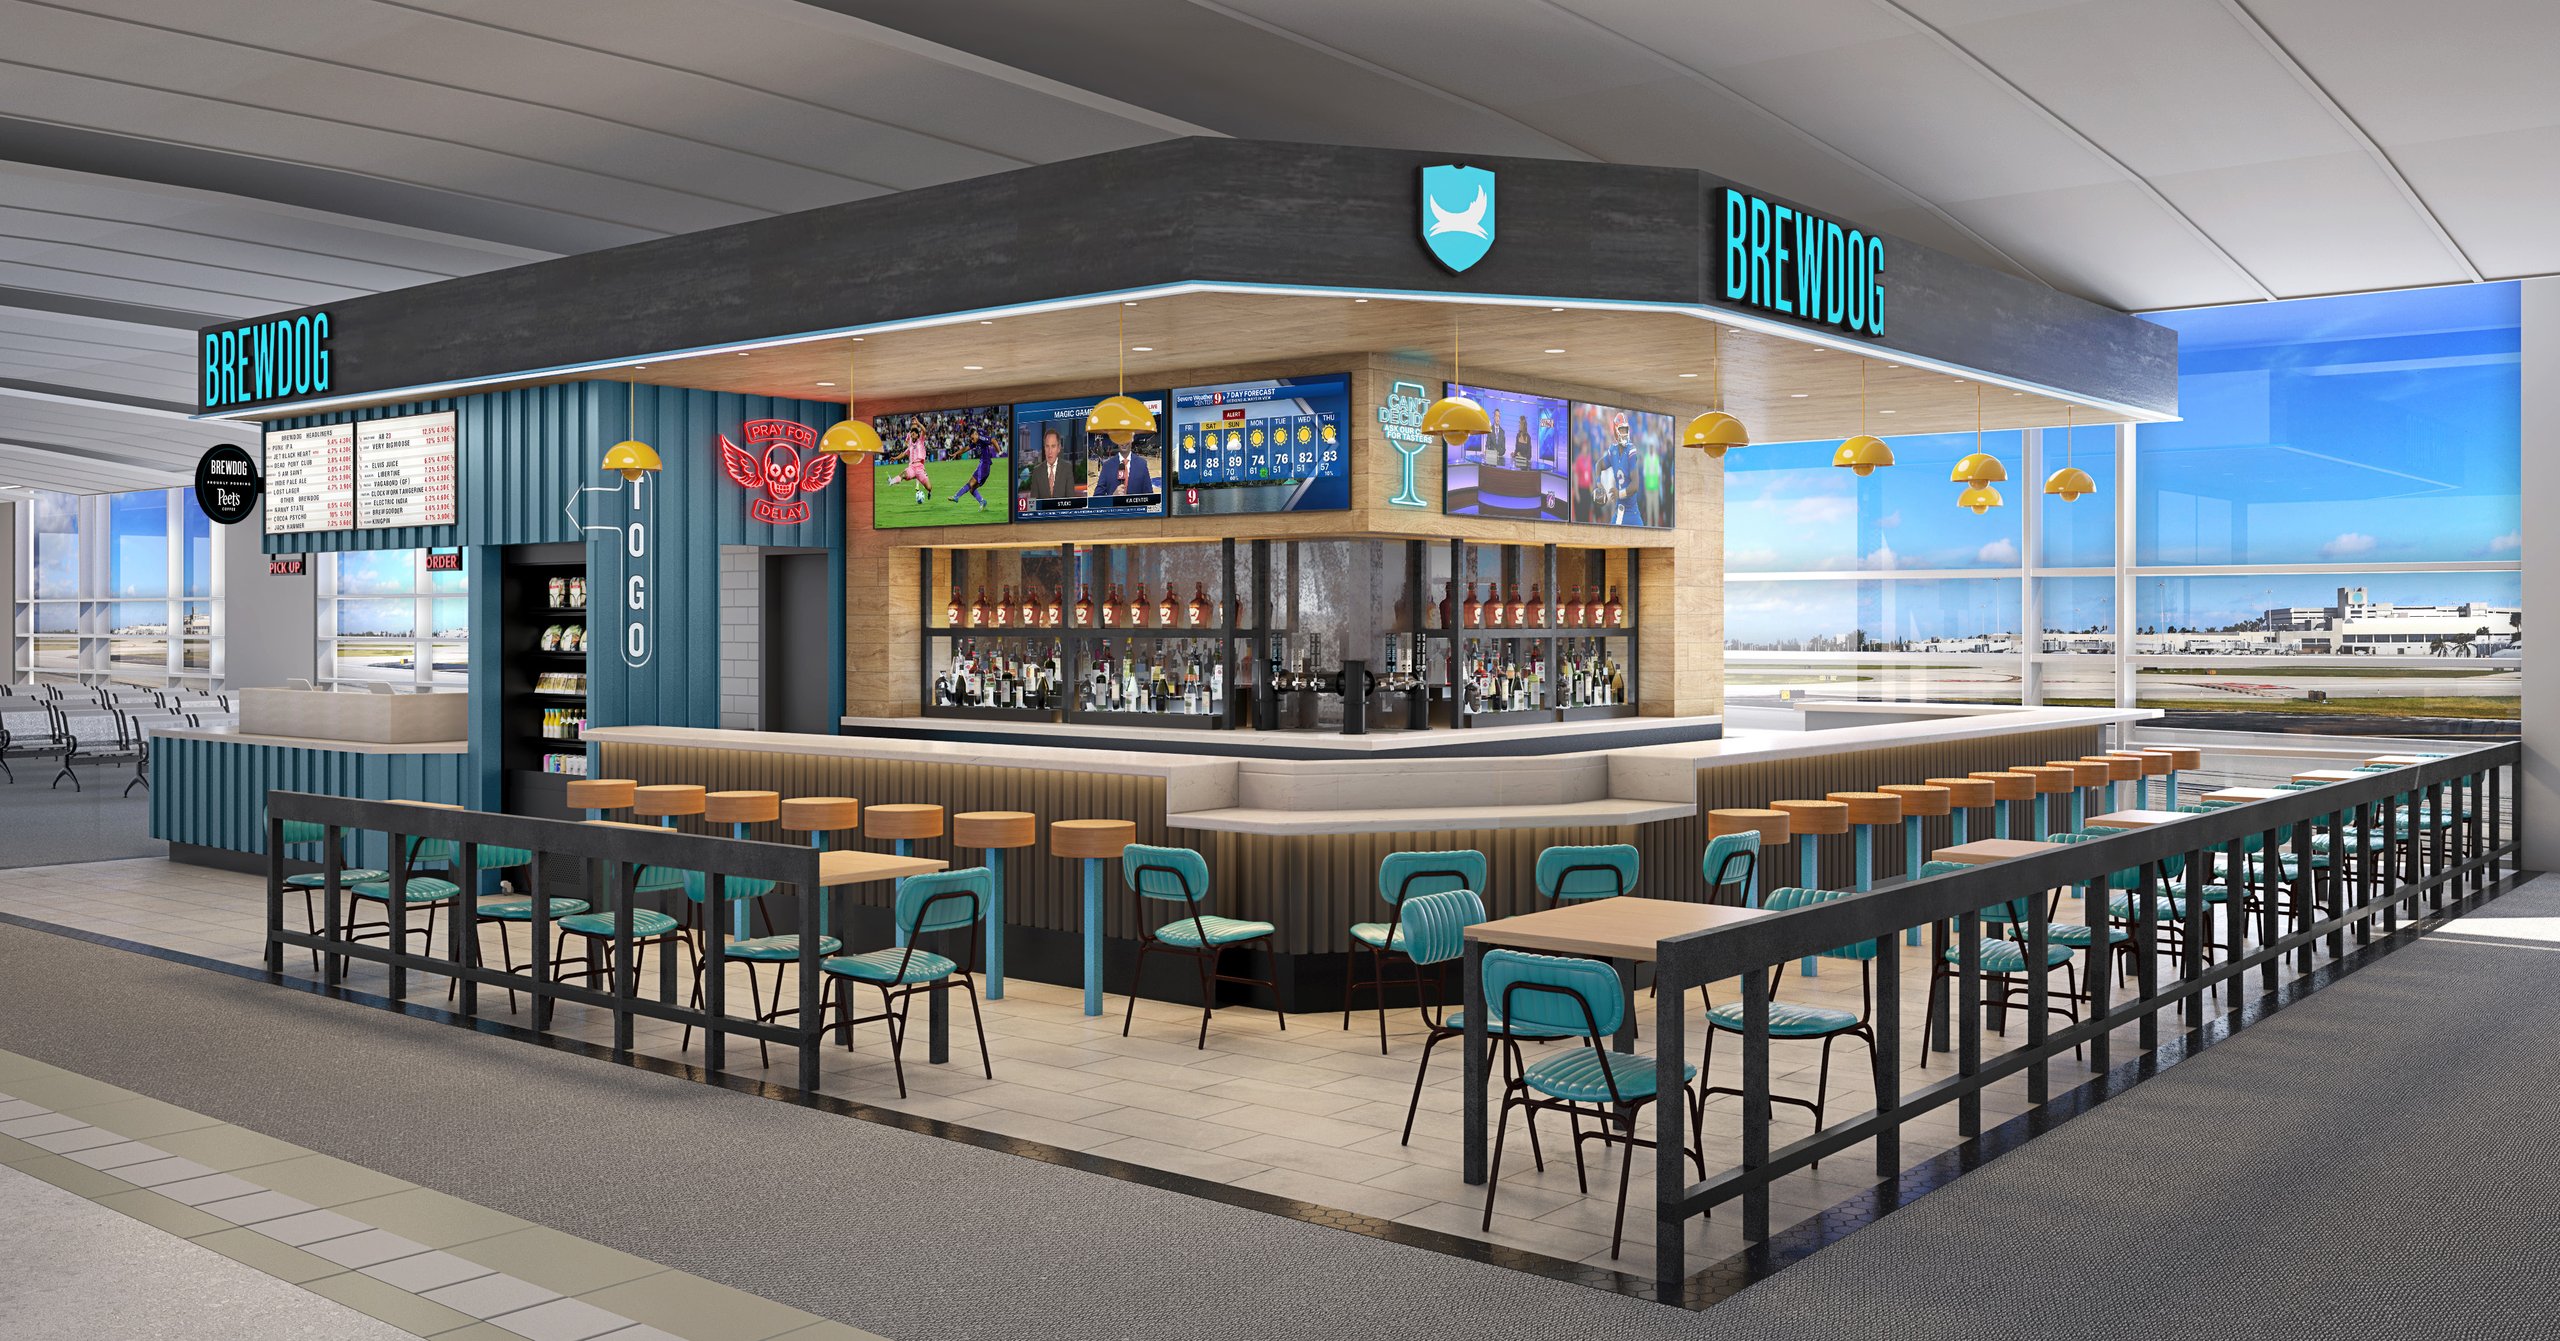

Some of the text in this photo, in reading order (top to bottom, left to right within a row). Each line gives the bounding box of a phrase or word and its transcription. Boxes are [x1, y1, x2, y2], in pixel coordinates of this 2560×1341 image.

[1726, 188, 1885, 337] BREWDOG
[206, 312, 329, 406] BREWDOG
[1244, 388, 1276, 397] FORECAST
[1214, 393, 1222, 404] 9
[1387, 394, 1430, 416] CAN'T
[1054, 410, 1075, 418] MAGIC
[1379, 407, 1422, 427] DECID
[306, 430, 332, 438] HEADLINERS
[752, 425, 812, 444] PRAY FOR
[1400, 426, 1414, 434] OUR
[1388, 431, 1433, 444] FOR TASTERS
[1228, 456, 1242, 467] 89
[1252, 455, 1265, 466] 74
[1275, 453, 1288, 464] 76
[1299, 452, 1312, 463] 82
[1323, 451, 1337, 462] 83
[211, 460, 247, 475] BREWDOG
[1184, 459, 1198, 470] 84
[1206, 457, 1219, 468] 88
[1297, 464, 1305, 472] 51
[1321, 463, 1329, 471] 57
[1203, 469, 1212, 477] 64
[1226, 468, 1234, 476] 70
[1273, 465, 1281, 473] 51
[217, 488, 240, 506] Peet's
[1188, 490, 1197, 502] 9
[1019, 500, 1026, 510] 9
[761, 504, 803, 520] DELAY
[270, 561, 300, 574] PICK UP
[426, 555, 457, 569] ORDER
[629, 475, 644, 658] TO GO
